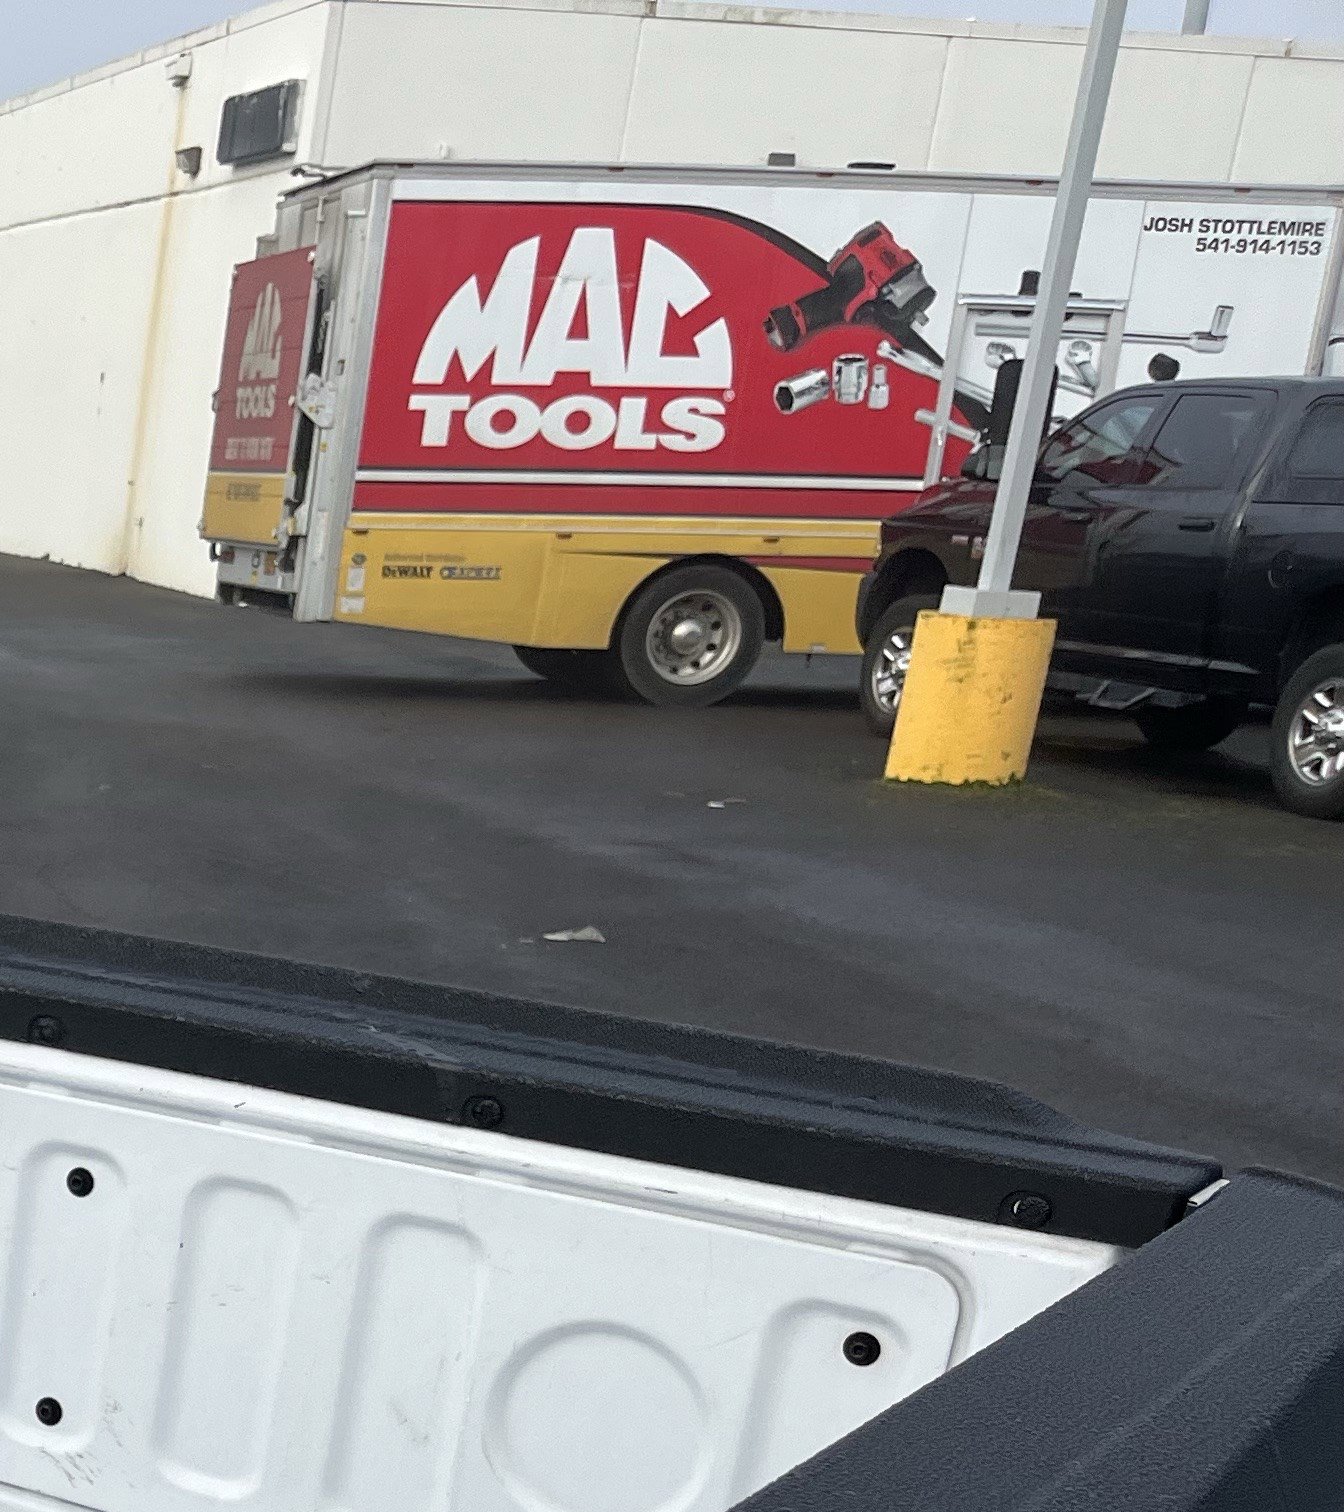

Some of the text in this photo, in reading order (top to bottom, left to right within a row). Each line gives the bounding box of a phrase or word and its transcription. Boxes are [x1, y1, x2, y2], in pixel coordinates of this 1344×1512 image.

[1143, 216, 1326, 237] JOSH STOTTLEMIRE
[1195, 237, 1323, 256] 541-914-1153
[238, 281, 283, 382] MAC
[412, 226, 733, 390] MAC
[235, 384, 278, 419] TOOLS
[408, 393, 727, 452] TOOLS
